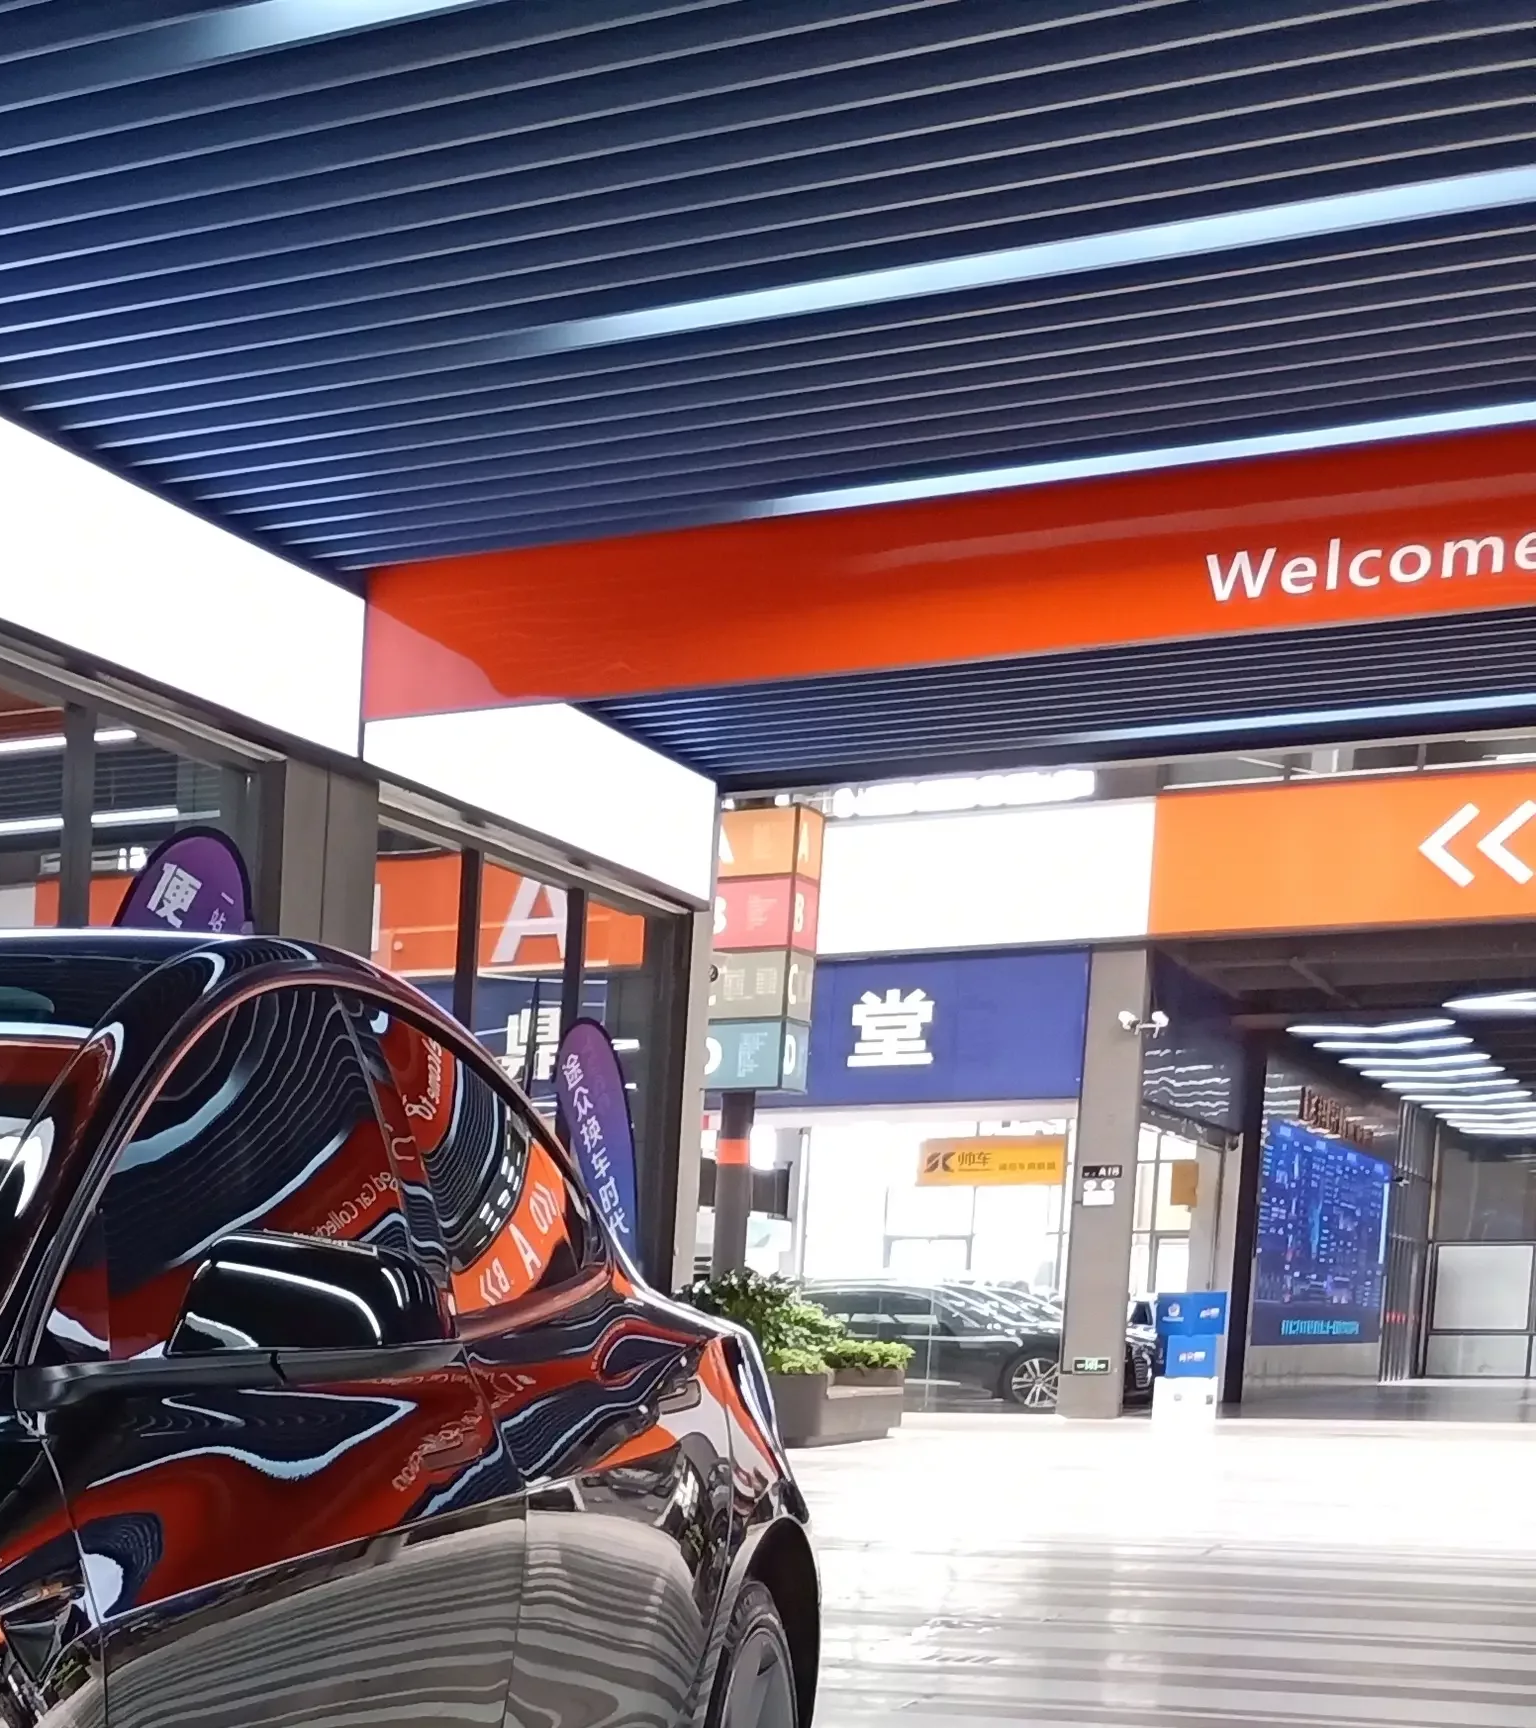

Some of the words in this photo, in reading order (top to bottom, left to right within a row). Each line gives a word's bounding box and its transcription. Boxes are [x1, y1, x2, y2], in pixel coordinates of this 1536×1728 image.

[146, 862, 204, 929] 便
[846, 988, 936, 1068] 堂
[561, 1053, 630, 1235] 途众换车时代
